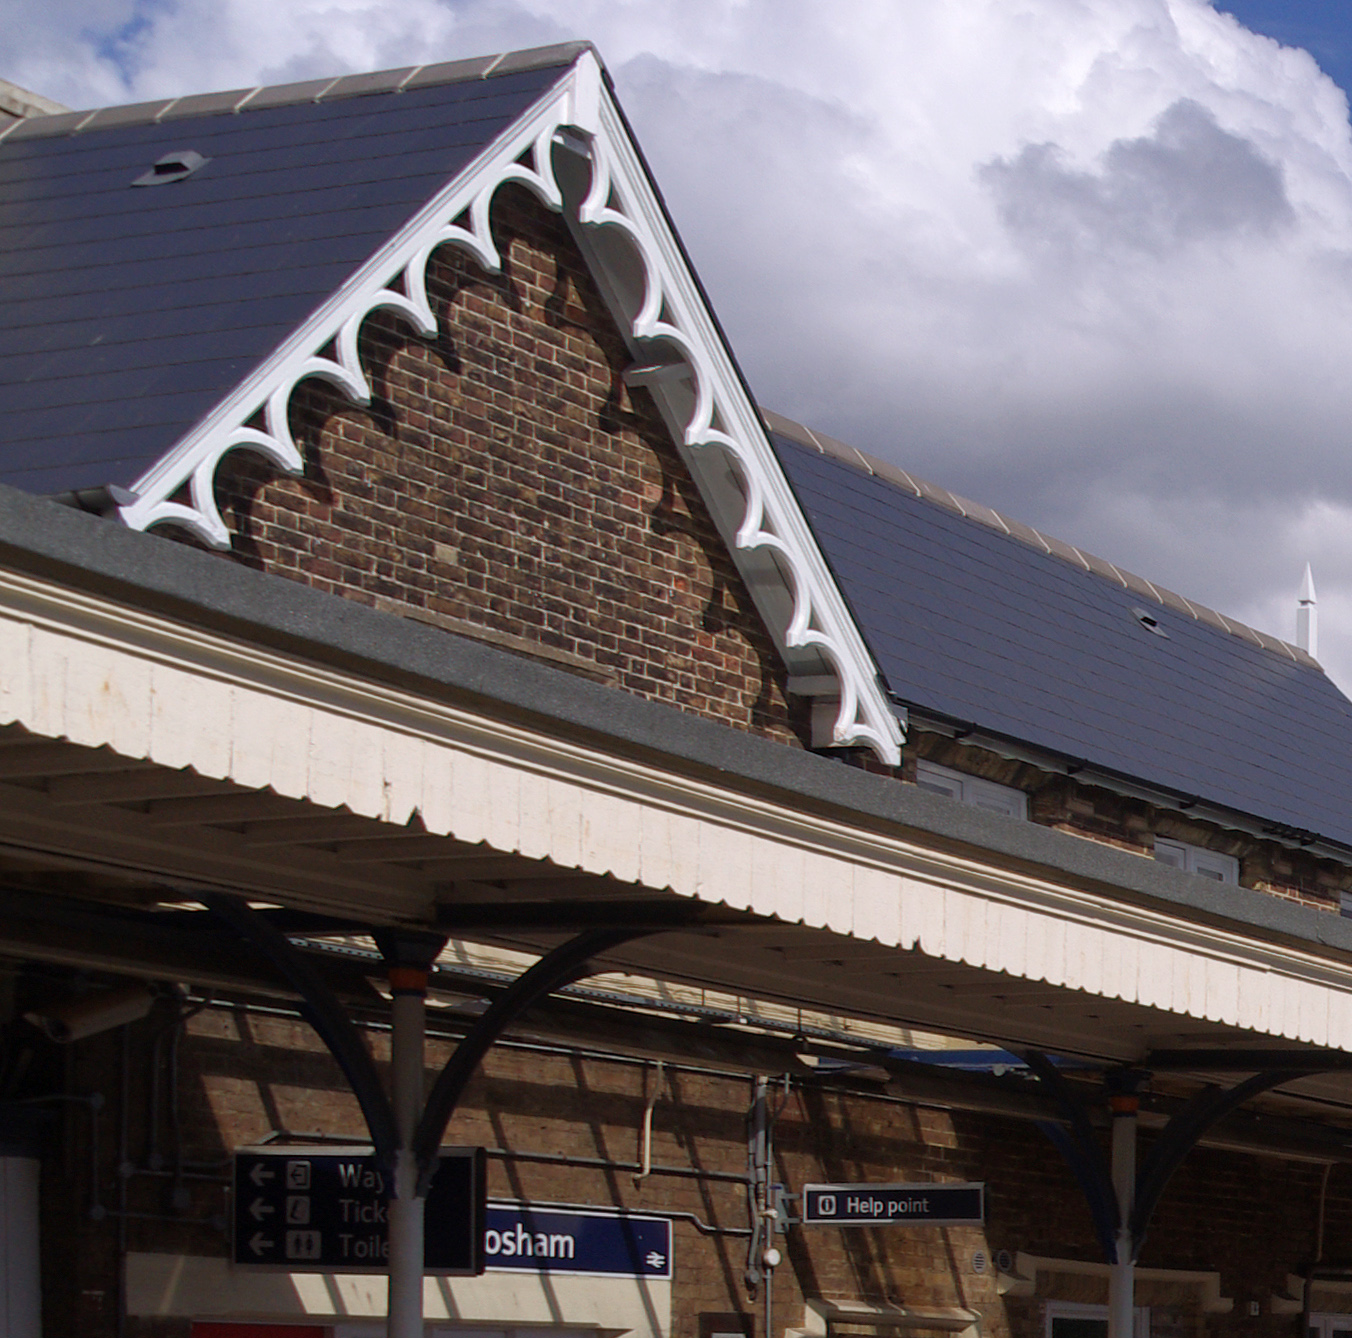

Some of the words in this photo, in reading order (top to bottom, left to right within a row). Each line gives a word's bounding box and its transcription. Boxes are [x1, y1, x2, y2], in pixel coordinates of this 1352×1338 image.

[338, 1162, 385, 1194] Way
[338, 1198, 390, 1224] Tick
[847, 1196, 885, 1217] Help
[887, 1197, 930, 1217] point
[485, 1222, 575, 1259] osham
